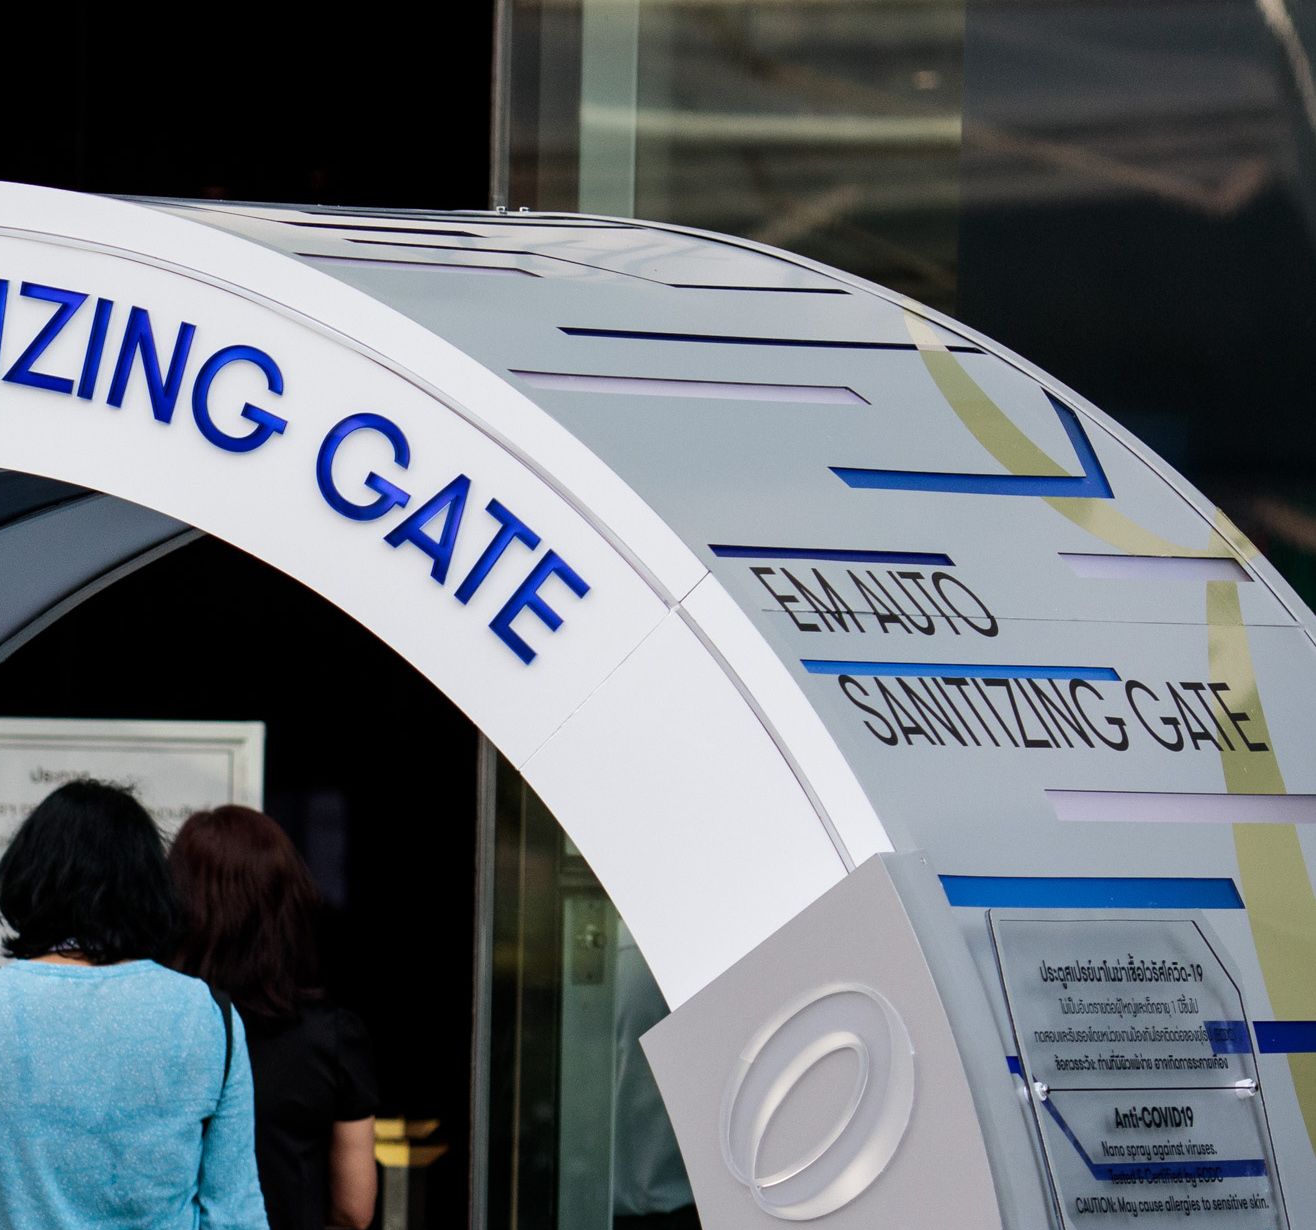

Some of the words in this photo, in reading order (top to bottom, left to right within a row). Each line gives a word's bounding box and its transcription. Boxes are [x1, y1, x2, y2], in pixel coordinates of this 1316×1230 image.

[316, 412, 592, 666] GATE
[749, 566, 866, 633] EM
[845, 569, 1000, 638] AUTO
[837, 674, 1130, 752] SANITIZING
[1124, 680, 1270, 752] GATE
[1114, 1106, 1194, 1128] Anti-COVID19
[1101, 1141, 1125, 1157] Nano
[1126, 1143, 1151, 1161] spray
[1152, 1140, 1184, 1160] against
[1185, 1139, 1217, 1156] viruses.
[1186, 1168, 1198, 1187] by
[1076, 1197, 1117, 1214] CAUTION:
[1118, 1197, 1138, 1217] May
[1139, 1200, 1164, 1212] cause
[1165, 1196, 1202, 1216] allergies
[1203, 1197, 1211, 1211] to
[1212, 1193, 1249, 1211] sensitive
[1250, 1193, 1270, 1210] skin.
